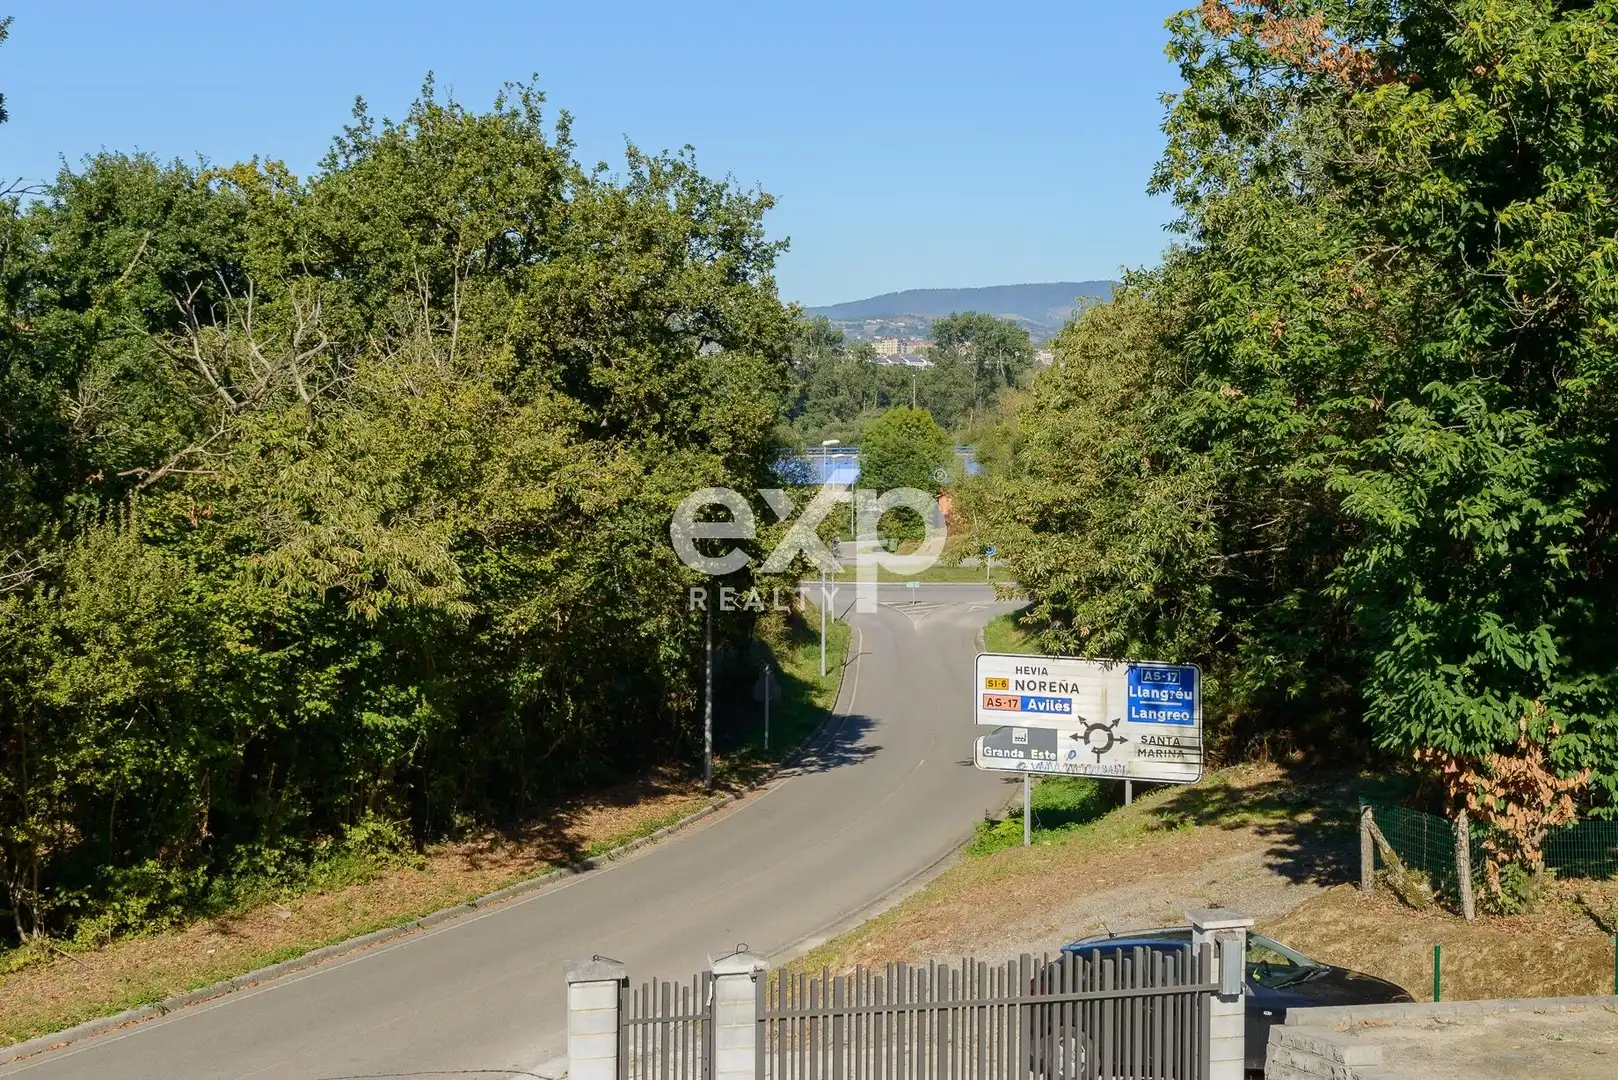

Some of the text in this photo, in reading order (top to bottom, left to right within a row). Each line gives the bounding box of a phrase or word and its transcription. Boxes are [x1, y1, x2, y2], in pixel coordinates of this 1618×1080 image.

[1015, 666, 1048, 676] HEVIA
[1143, 672, 1178, 682] AS-17
[1015, 679, 1079, 694] NOREÑA
[1129, 685, 1193, 701] Llangréu
[986, 698, 1071, 712] AS-17 Avilés
[1131, 707, 1190, 721] Langreo
[1140, 735, 1180, 746] SANTA
[983, 747, 1057, 760] Granda Este
[1137, 748, 1185, 759] MARINA
